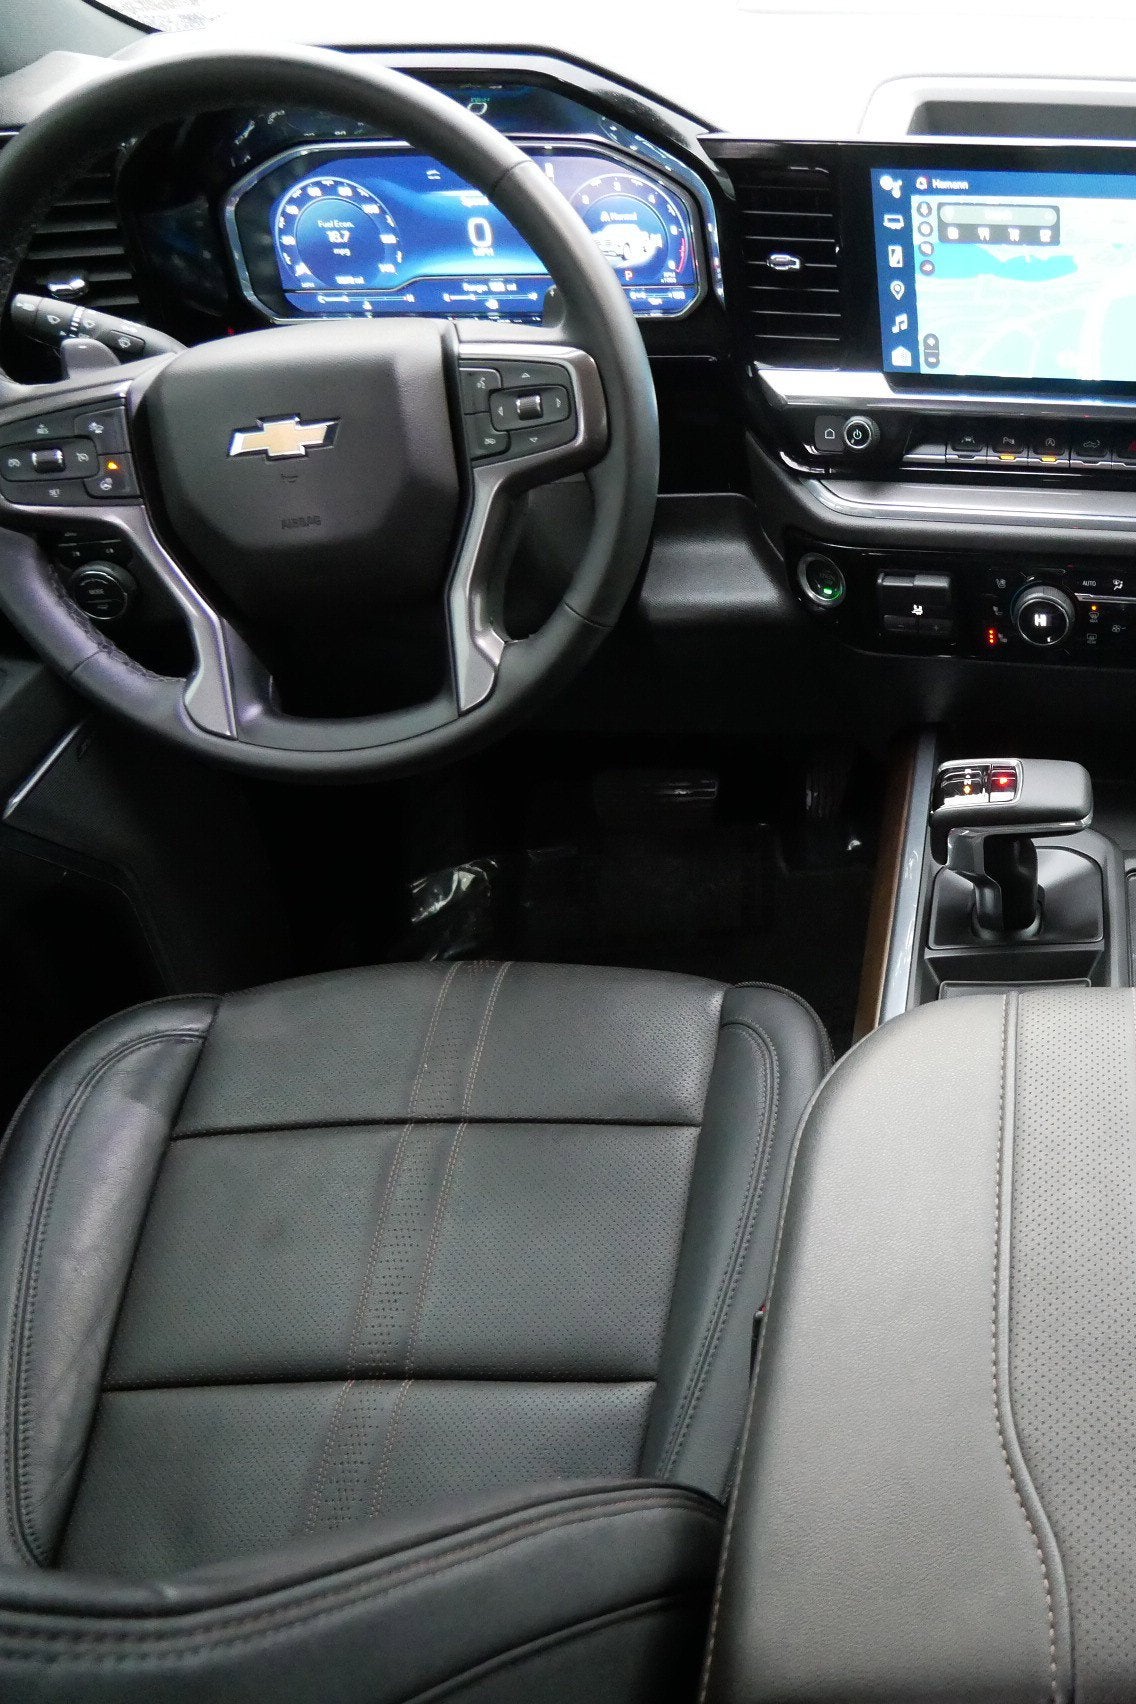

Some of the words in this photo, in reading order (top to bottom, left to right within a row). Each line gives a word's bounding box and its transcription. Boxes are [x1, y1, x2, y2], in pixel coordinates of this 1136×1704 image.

[318, 219, 334, 228] Fuel
[467, 217, 493, 247] 0
[624, 270, 633, 281] P
[1034, 613, 1047, 627] HI
